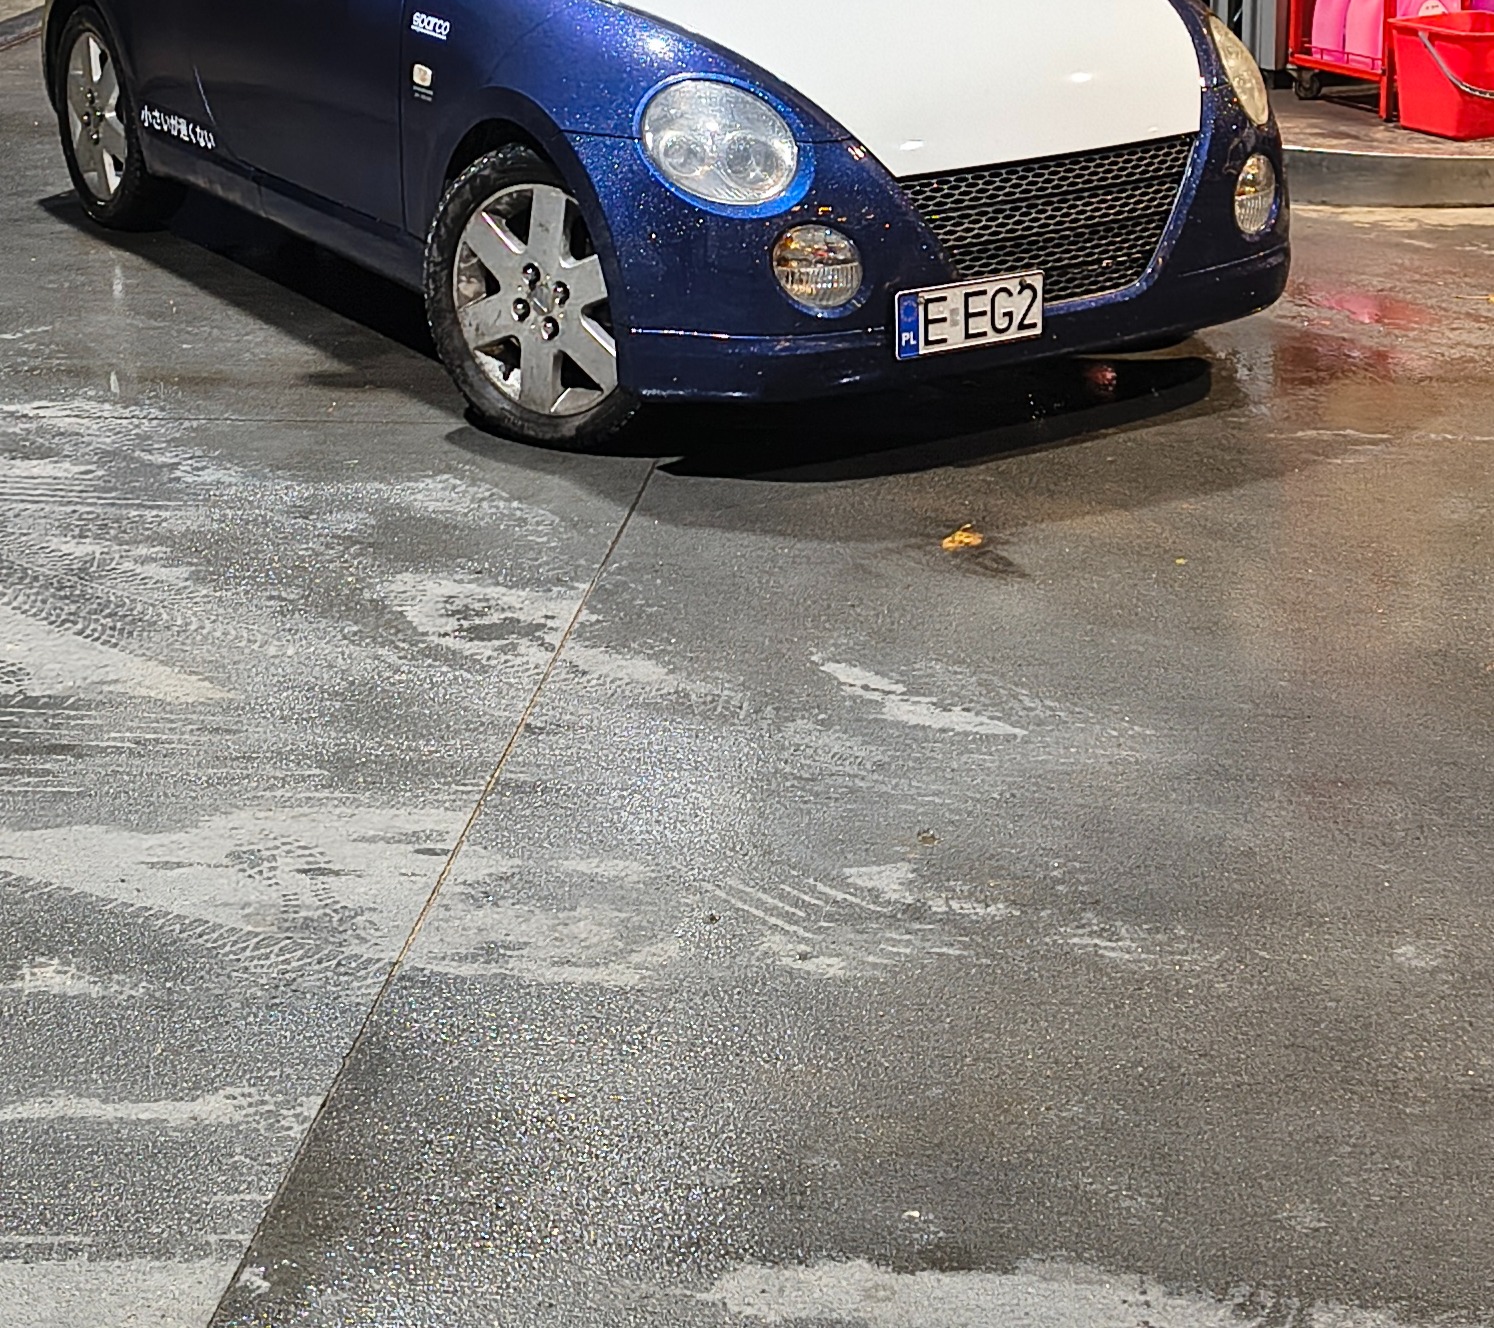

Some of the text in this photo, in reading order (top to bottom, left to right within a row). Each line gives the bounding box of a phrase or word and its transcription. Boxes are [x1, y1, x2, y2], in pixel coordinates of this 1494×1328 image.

[923, 282, 1038, 347] E EG2
[901, 331, 917, 347] PL
